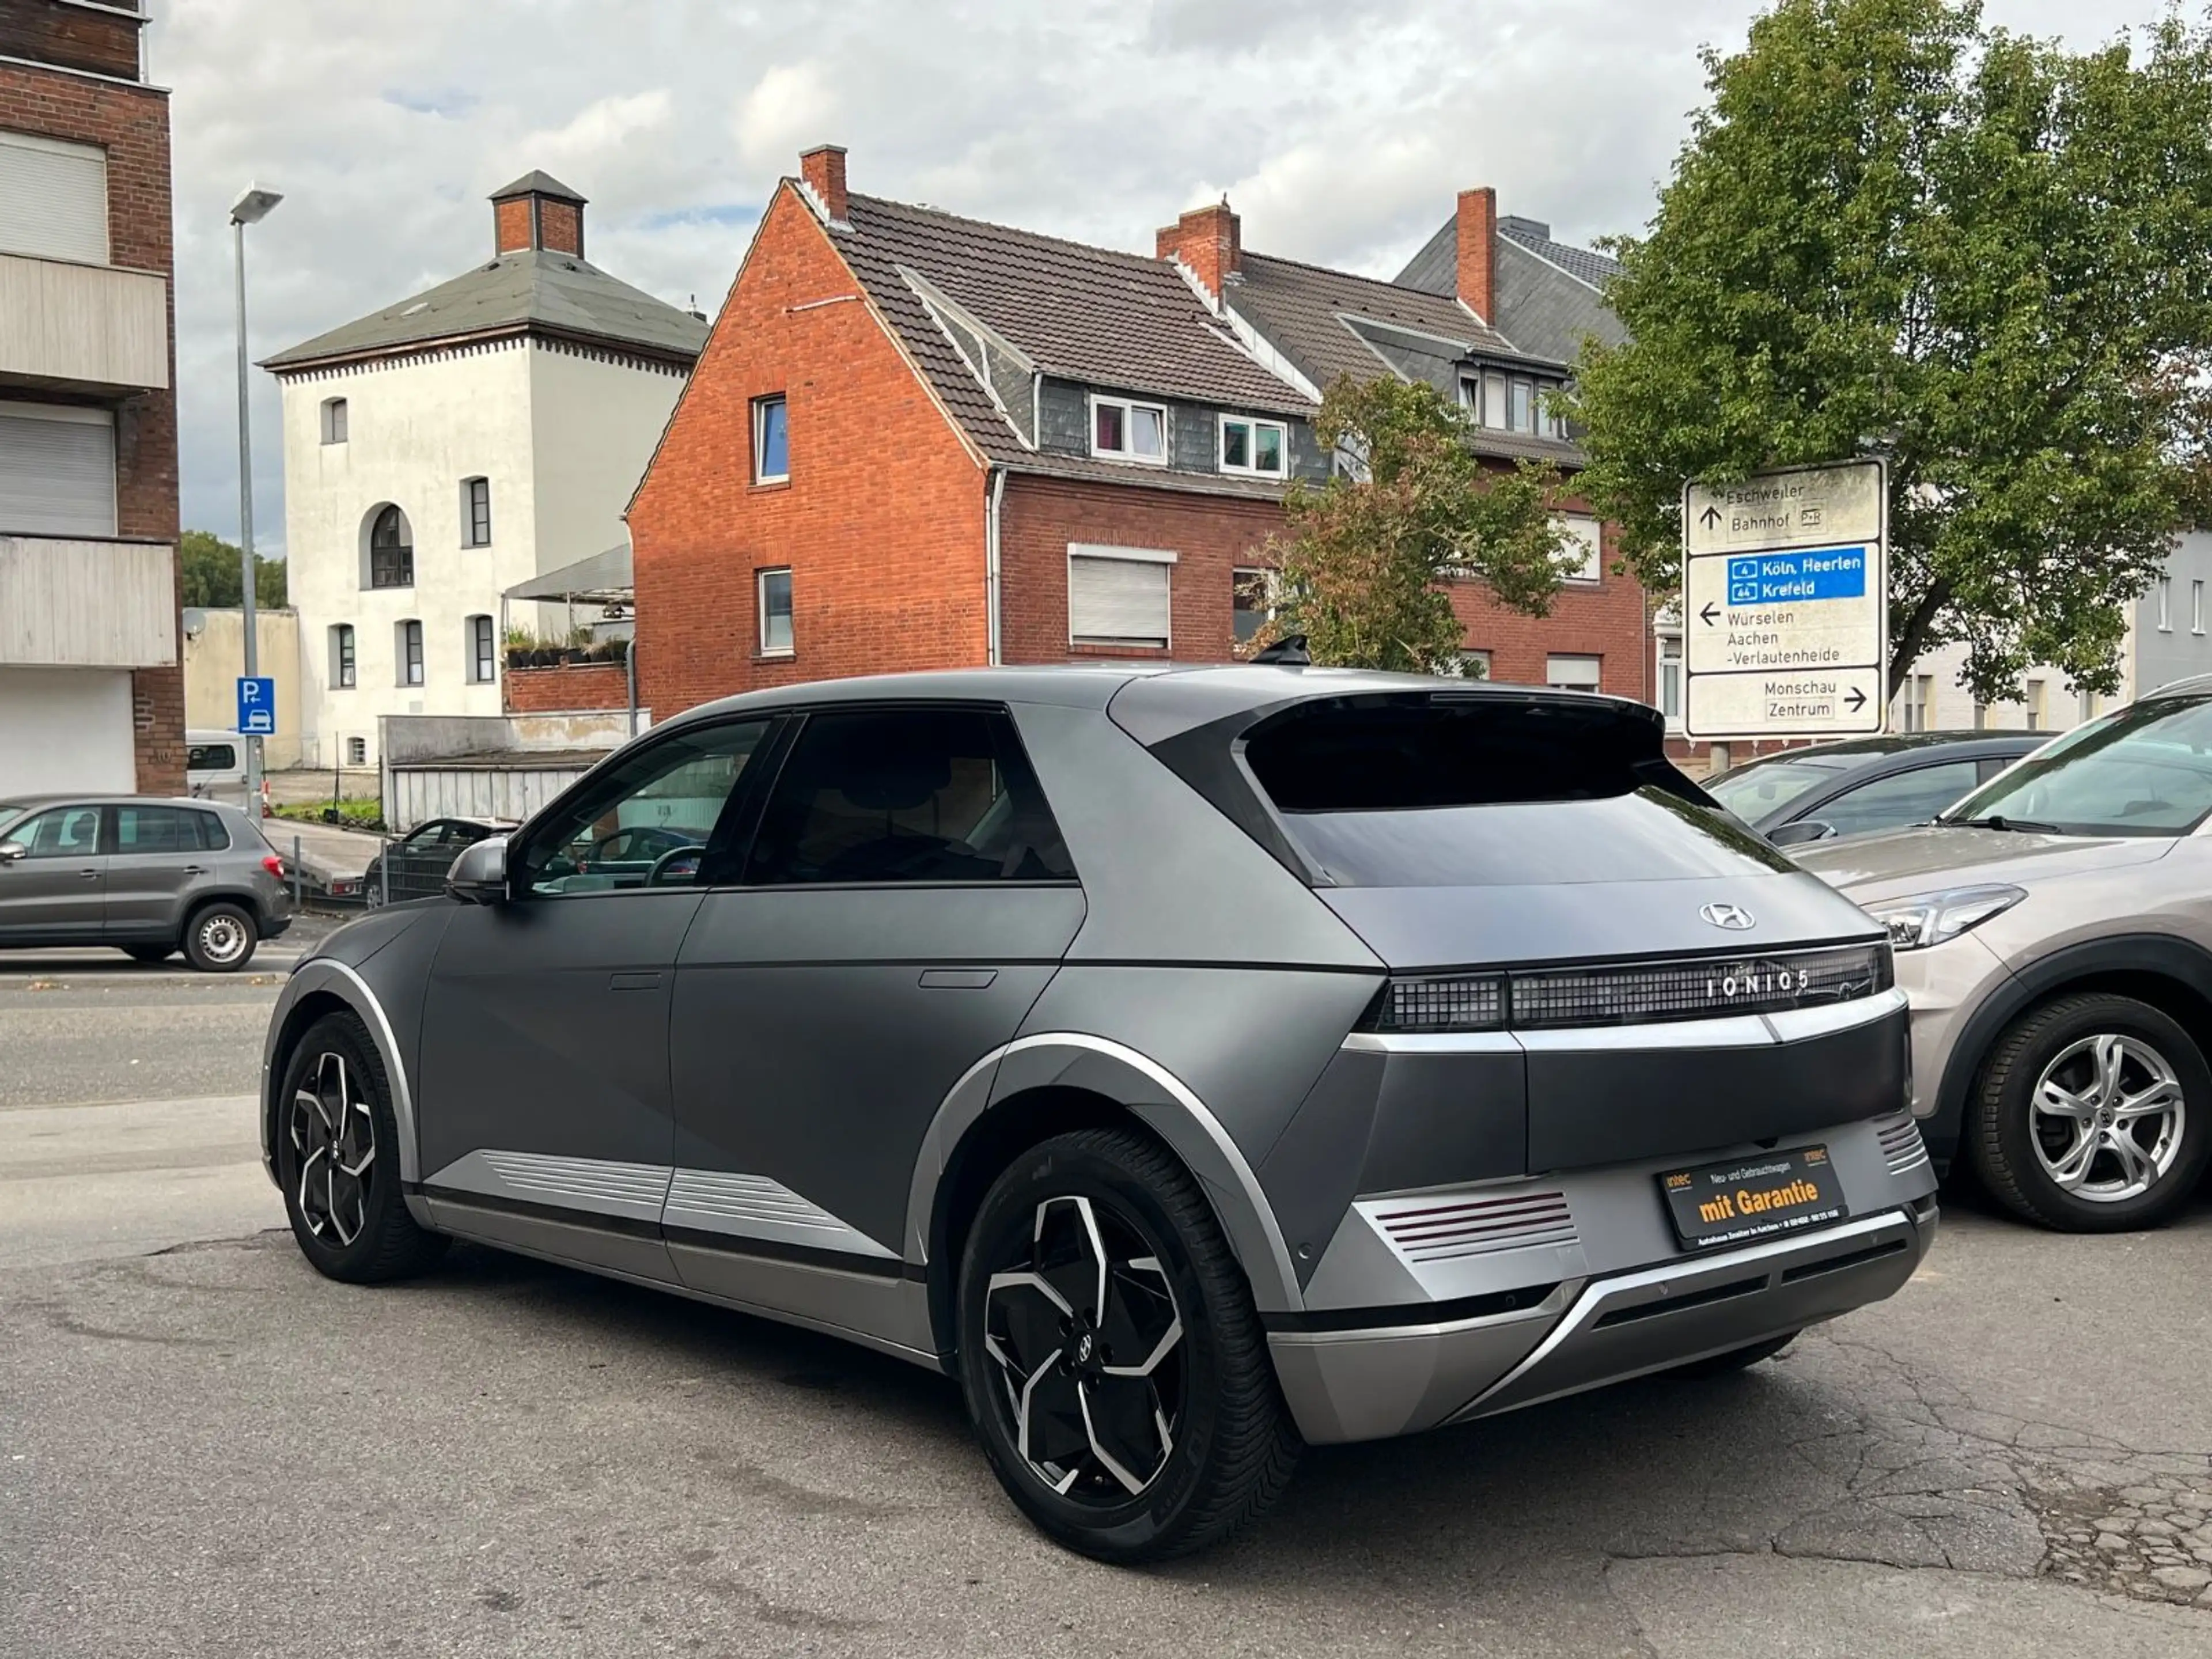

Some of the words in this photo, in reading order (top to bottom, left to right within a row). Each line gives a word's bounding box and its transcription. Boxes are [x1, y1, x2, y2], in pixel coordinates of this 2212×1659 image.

[1727, 484, 1805, 504] Eschweiler
[1732, 513, 1790, 532] Bahnhof
[1741, 565, 1749, 575] 4
[1802, 556, 1861, 573] Heerlen
[1737, 586, 1751, 597] 44
[1762, 580, 1815, 598] Krefeld
[1728, 611, 1794, 626] Würselen
[1727, 631, 1778, 646] Aachen
[1727, 647, 1840, 665] -Verlautenheide
[243, 681, 259, 703] P
[1765, 680, 1836, 695] Monschau
[1769, 702, 1830, 717] Zentrum
[1707, 972, 1791, 997] IONIQ
[1798, 969, 1808, 988] 5
[1728, 1169, 1740, 1181] und
[1699, 1194, 1736, 1223] mit
[1736, 1179, 1819, 1215] Garantie
